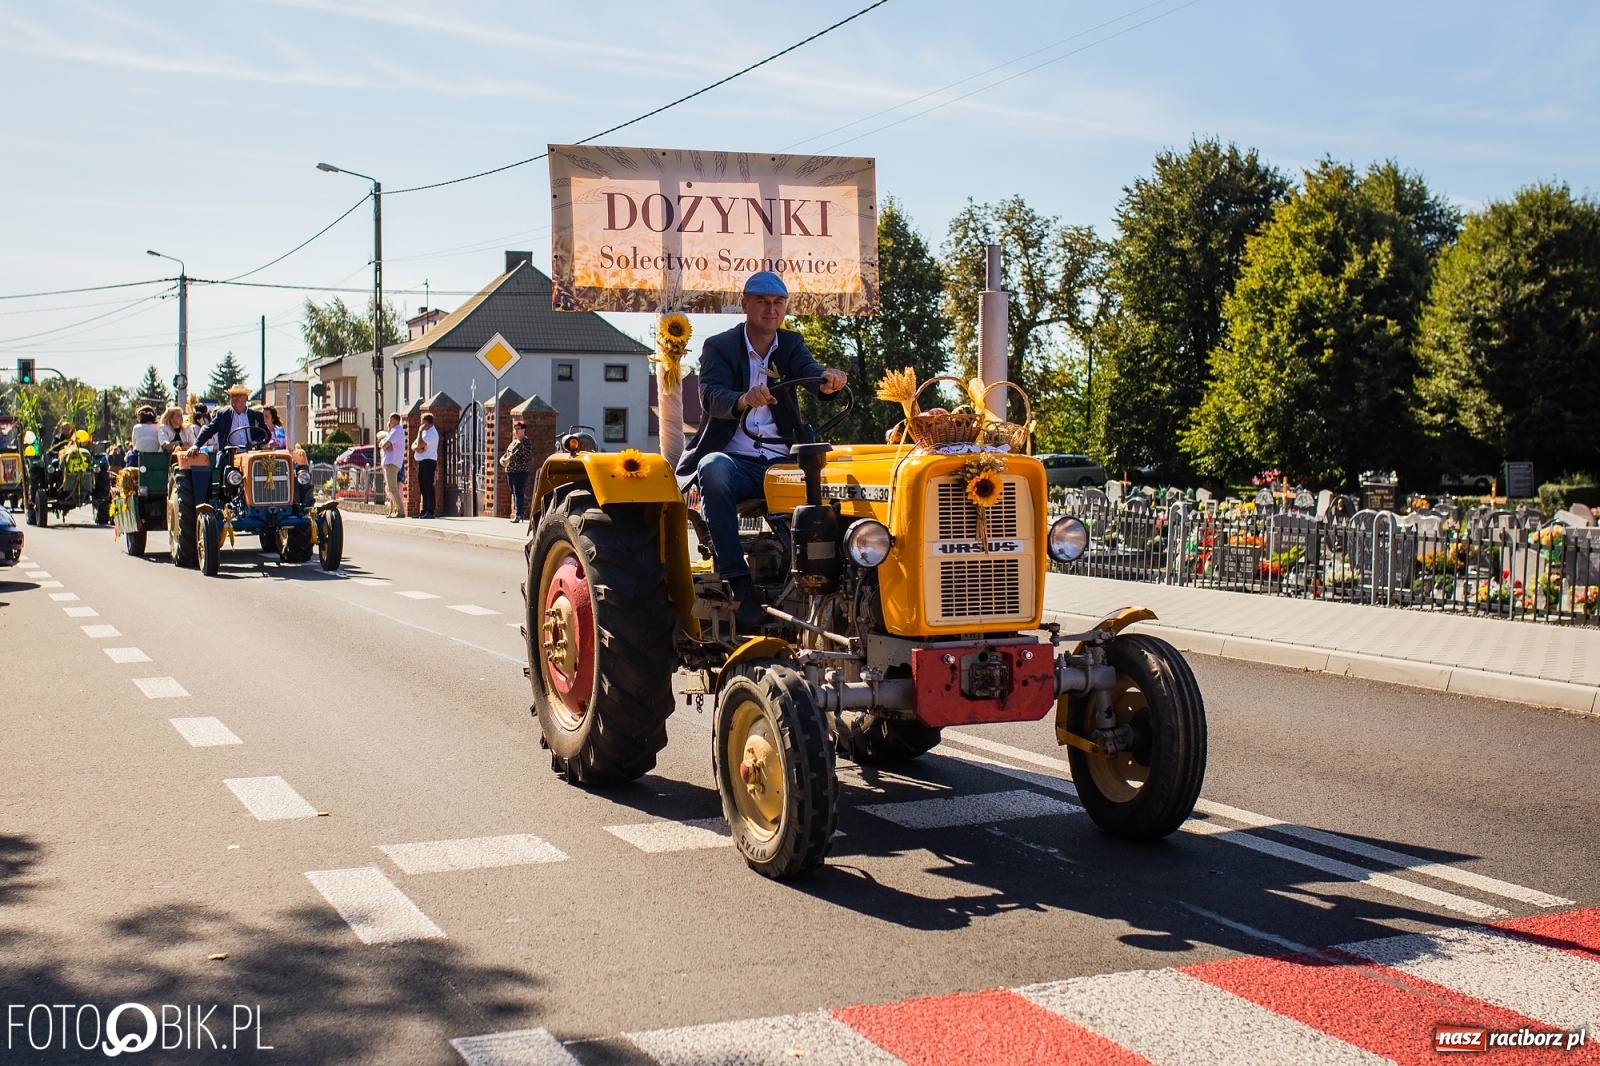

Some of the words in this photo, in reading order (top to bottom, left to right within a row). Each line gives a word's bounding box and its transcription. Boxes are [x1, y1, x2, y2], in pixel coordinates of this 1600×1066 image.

[602, 181, 833, 237] DOŻYNKI
[600, 245, 708, 271] Sołectwo
[718, 248, 838, 274] Szonowice
[821, 485, 857, 499] RSUS
[939, 541, 1018, 554] URSUS
